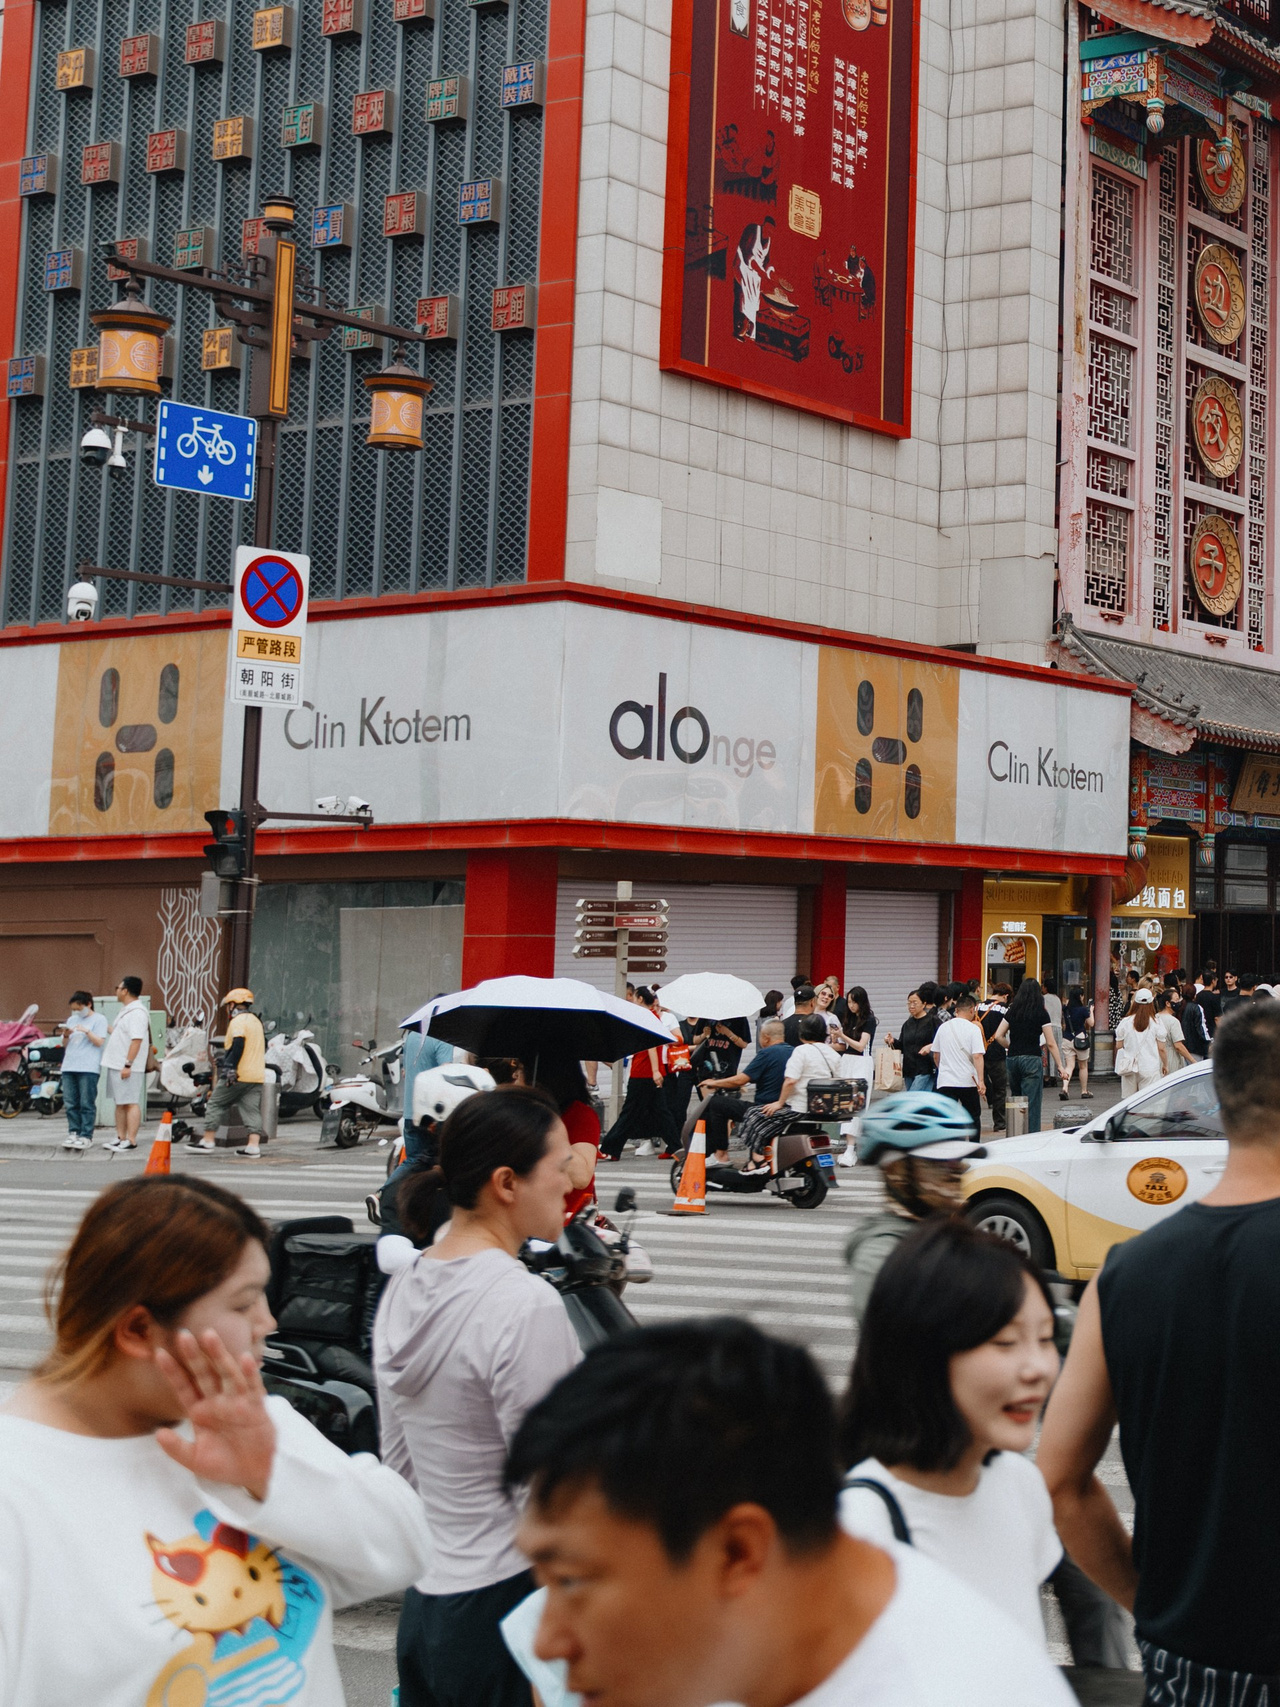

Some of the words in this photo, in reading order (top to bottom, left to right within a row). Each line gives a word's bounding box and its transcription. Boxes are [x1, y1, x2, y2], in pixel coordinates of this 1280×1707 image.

[242, 635, 297, 658] 严管路段
[240, 668, 295, 690] 朝阳街
[284, 700, 346, 750] Clin
[359, 696, 471, 747] Ktotem
[609, 671, 777, 779] alonge
[987, 740, 1029, 785] Clin
[1037, 746, 1104, 793] Ktotem
